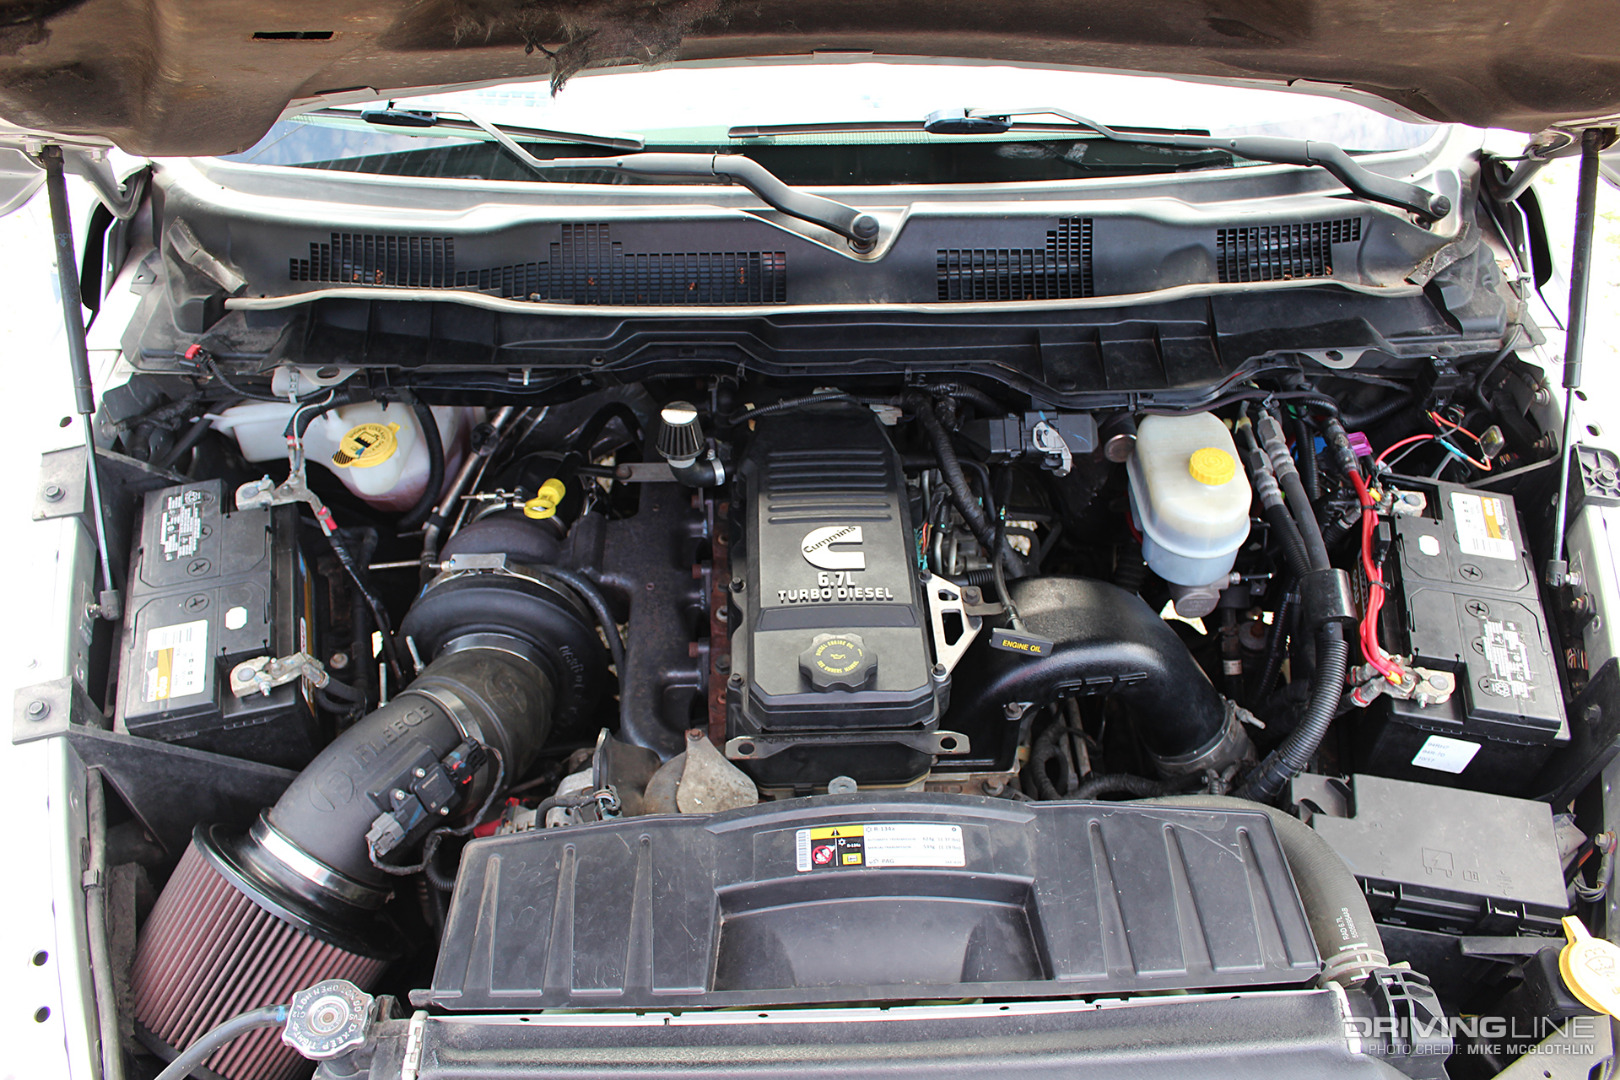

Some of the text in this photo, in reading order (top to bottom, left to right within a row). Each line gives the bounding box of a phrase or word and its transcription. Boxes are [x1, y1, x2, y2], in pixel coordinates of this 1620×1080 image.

[803, 525, 856, 553] Cummins
[818, 571, 856, 588] 6.7L
[778, 587, 894, 603] TURBO DIESEL
[1002, 639, 1042, 653] ENGINE OIL
[351, 704, 434, 771] FLEECE
[312, 984, 339, 996] OPEN
[322, 1031, 350, 1050] KEEP
